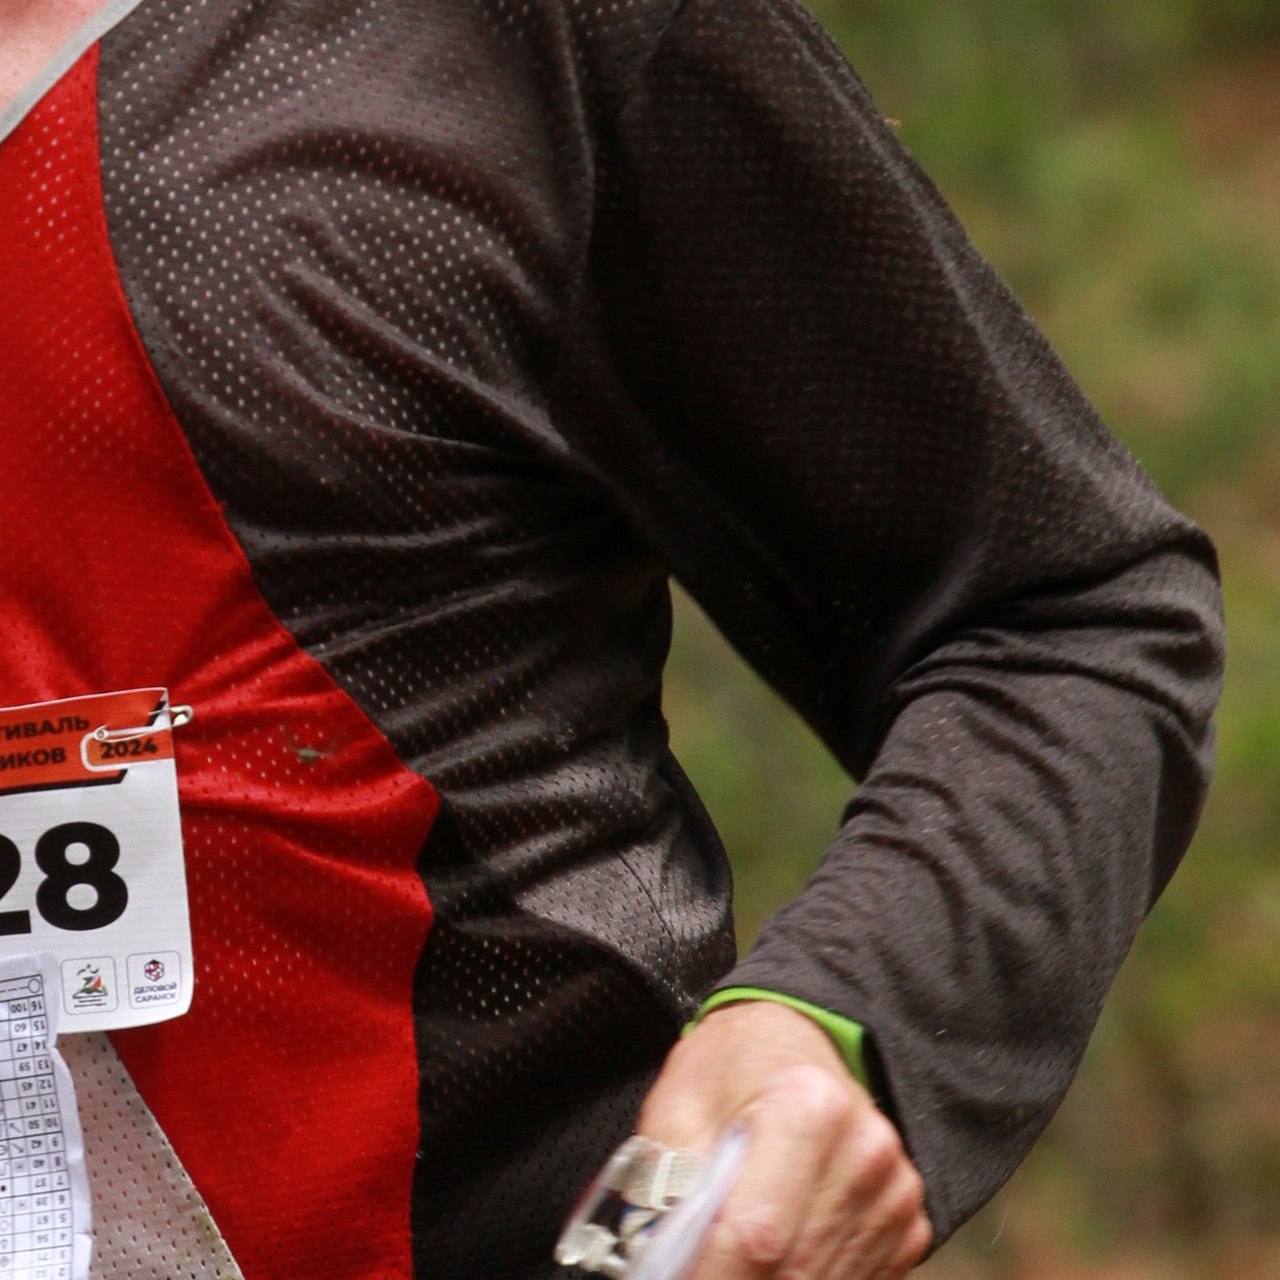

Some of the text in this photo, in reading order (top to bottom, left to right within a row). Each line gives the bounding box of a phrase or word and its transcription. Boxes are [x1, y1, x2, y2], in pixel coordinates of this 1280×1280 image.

[100, 737, 158, 761] 2024
[133, 982, 177, 995] ДЕЛОВОЙ
[135, 992, 176, 1003] САРАНСК
[10, 1000, 42, 1014] 16 100
[33, 1019, 45, 1030] 15
[17, 1040, 47, 1053] 14 47
[38, 1059, 49, 1069] 13
[39, 1078, 52, 1088] 12
[43, 1098, 55, 1108] 11
